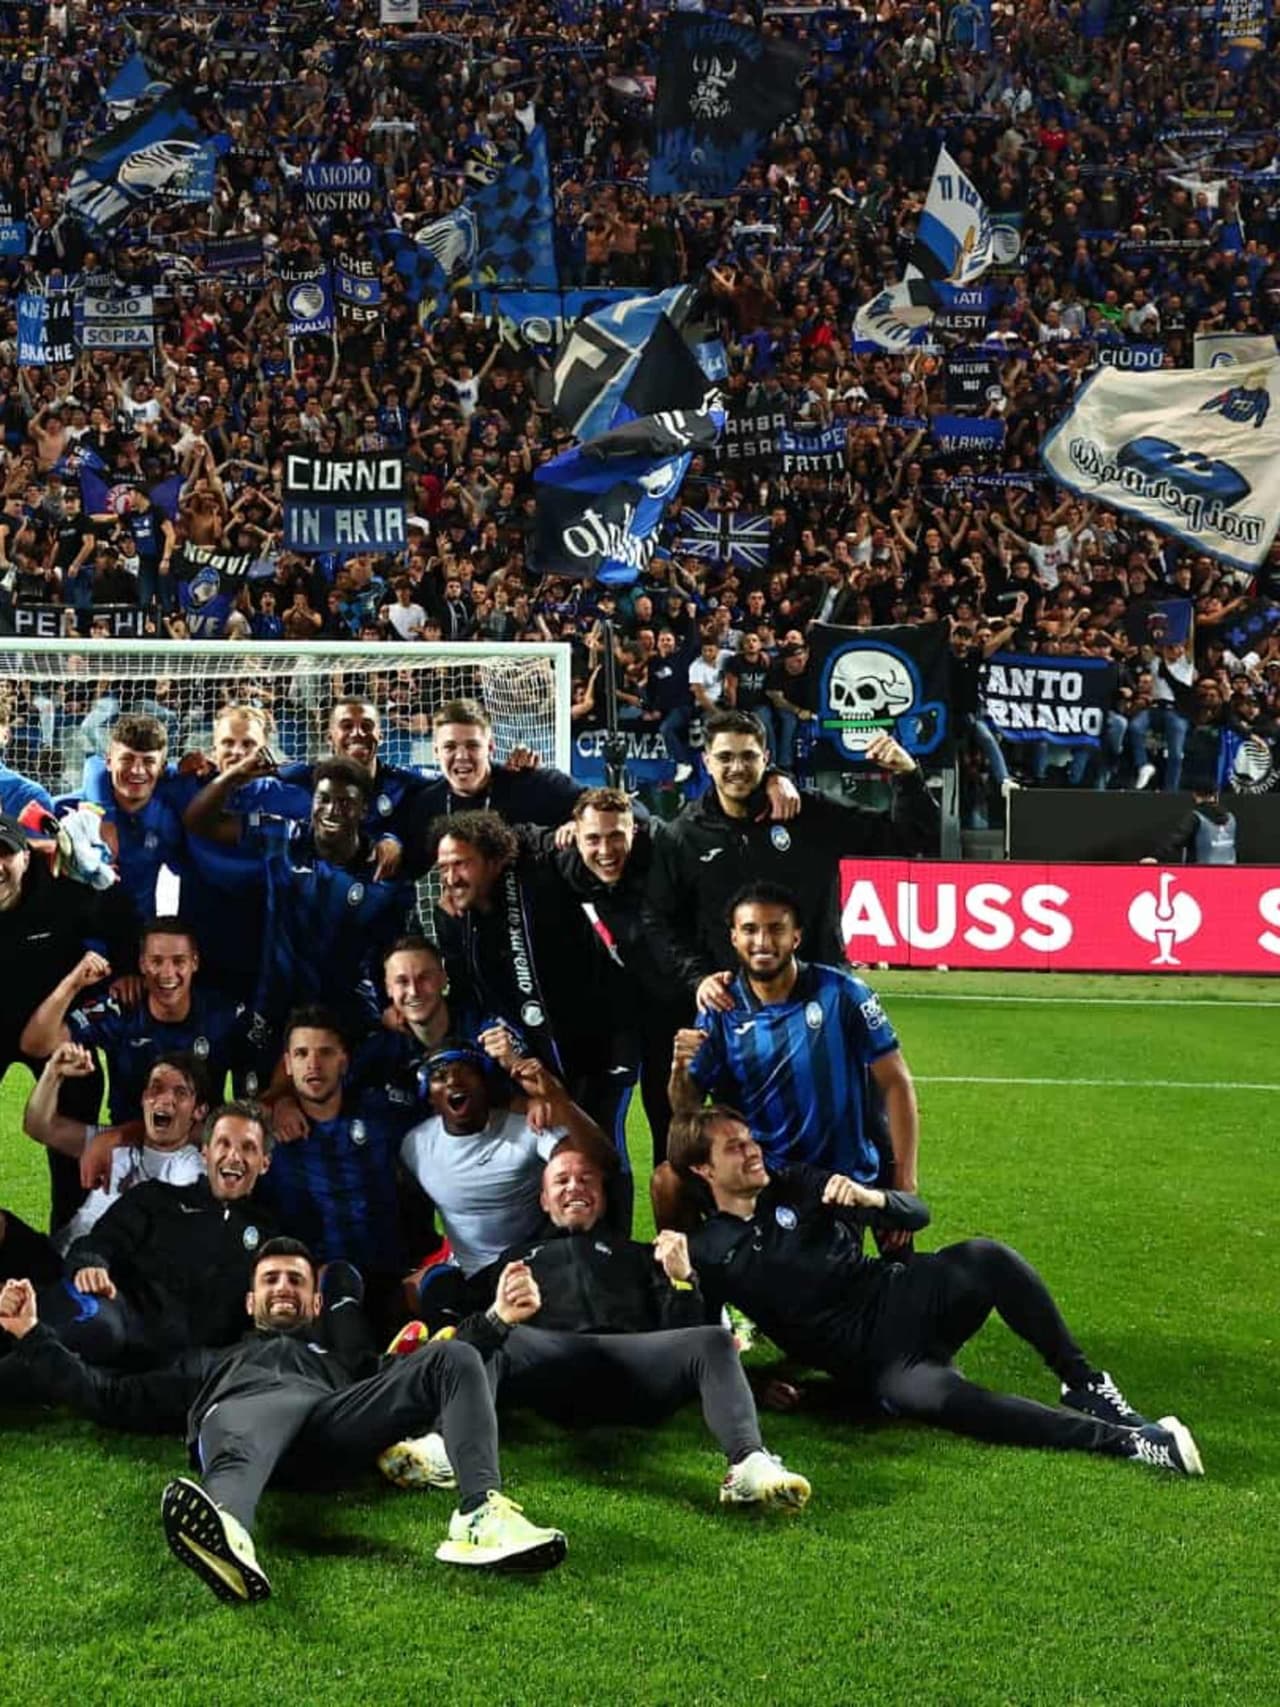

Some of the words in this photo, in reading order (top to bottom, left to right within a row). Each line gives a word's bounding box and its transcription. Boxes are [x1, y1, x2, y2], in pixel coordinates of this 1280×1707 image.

[305, 167, 316, 186] A
[320, 165, 372, 185] MODO
[305, 191, 371, 211] NOSTRO
[339, 252, 374, 275] CHE
[21, 300, 70, 320] ANSIA
[95, 300, 140, 314] OSIO
[725, 414, 787, 435] AMBA
[288, 455, 402, 491] CURNO
[783, 452, 845, 473] FATTI
[291, 508, 320, 545] IN
[335, 507, 404, 544] ARIA
[980, 664, 1083, 701] ANTO
[983, 697, 1103, 737] RNANO
[841, 879, 1074, 953] AUSS
